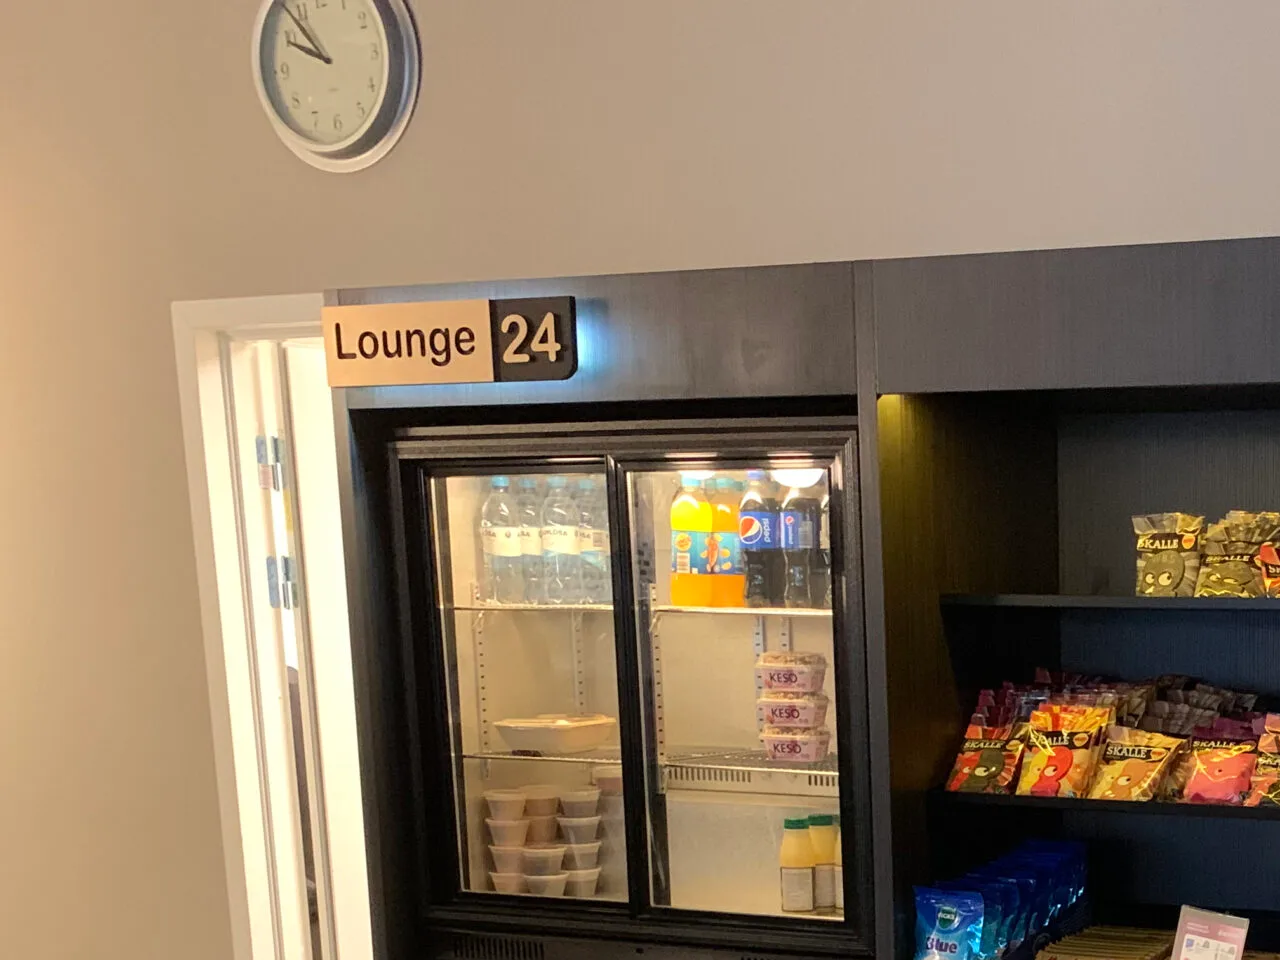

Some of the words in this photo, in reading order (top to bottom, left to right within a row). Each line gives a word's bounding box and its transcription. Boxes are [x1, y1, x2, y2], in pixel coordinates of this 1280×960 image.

[357, 11, 368, 29] 2
[371, 43, 379, 60] 3
[280, 62, 290, 80] 9
[368, 76, 376, 92] 4
[356, 101, 365, 118] 5
[311, 110, 319, 129] 7
[333, 113, 343, 131] 6
[334, 322, 476, 367] Lounge
[500, 311, 562, 364] 24
[1136, 538, 1179, 549] SKALLE
[769, 672, 798, 683] KESO
[771, 708, 800, 719] KESO
[773, 743, 802, 754] KESO
[1106, 746, 1147, 759] SKALLE
[926, 936, 958, 954] Blue
